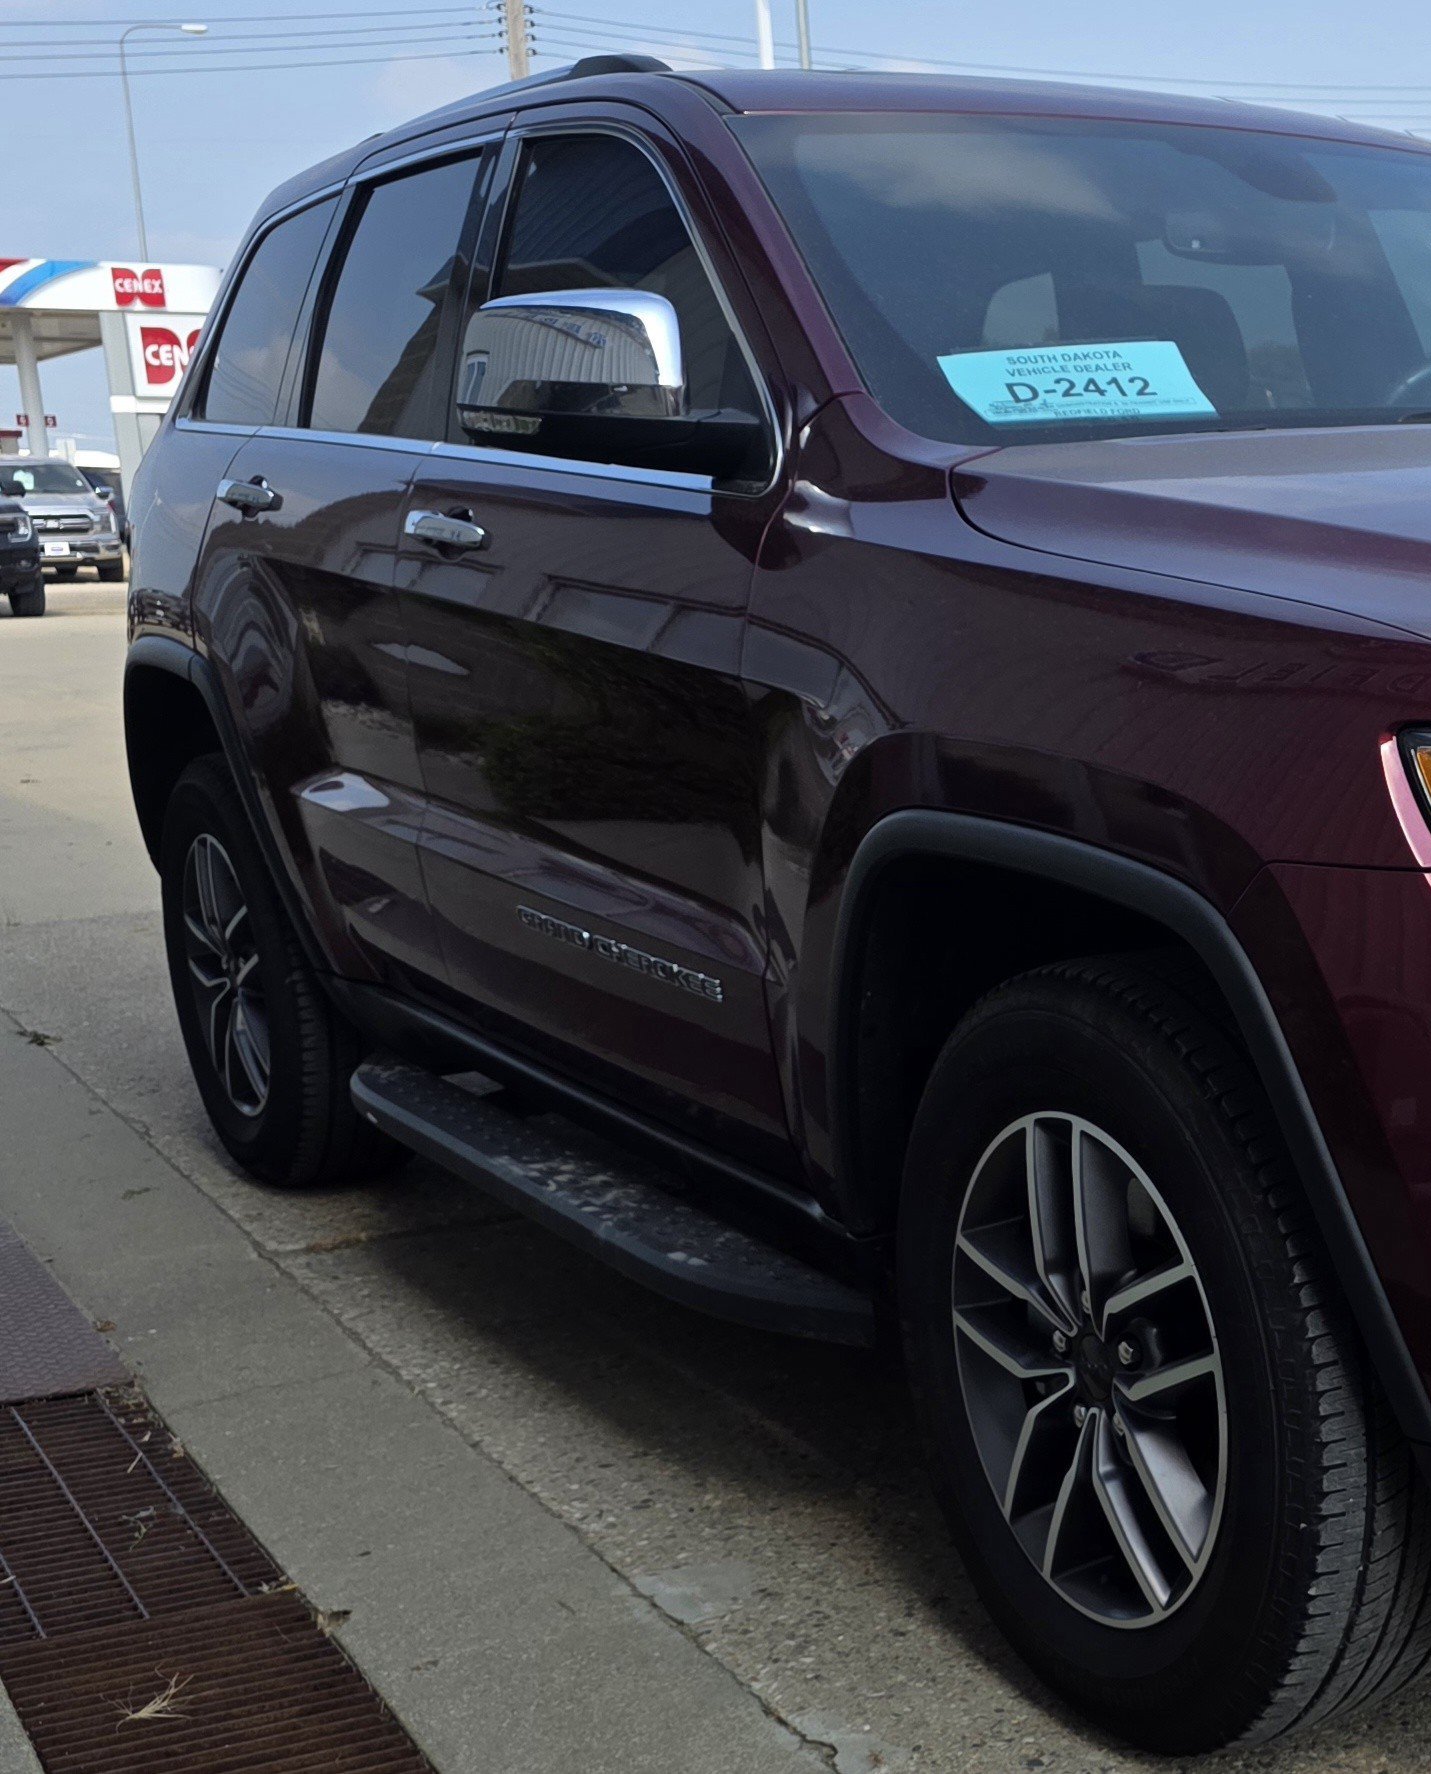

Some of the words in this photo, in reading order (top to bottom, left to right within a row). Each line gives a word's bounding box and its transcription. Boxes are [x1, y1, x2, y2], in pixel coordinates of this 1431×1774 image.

[113, 277, 163, 294] CENEX
[1006, 354, 1058, 366] SOUTH
[1060, 350, 1123, 363] DAKOTA
[1005, 365, 1071, 378] VEHICLE
[1073, 362, 1133, 374] DEALER
[1004, 376, 1159, 404] D-2412
[515, 904, 593, 949] GRAND
[592, 934, 724, 1003] CHEROKEE
